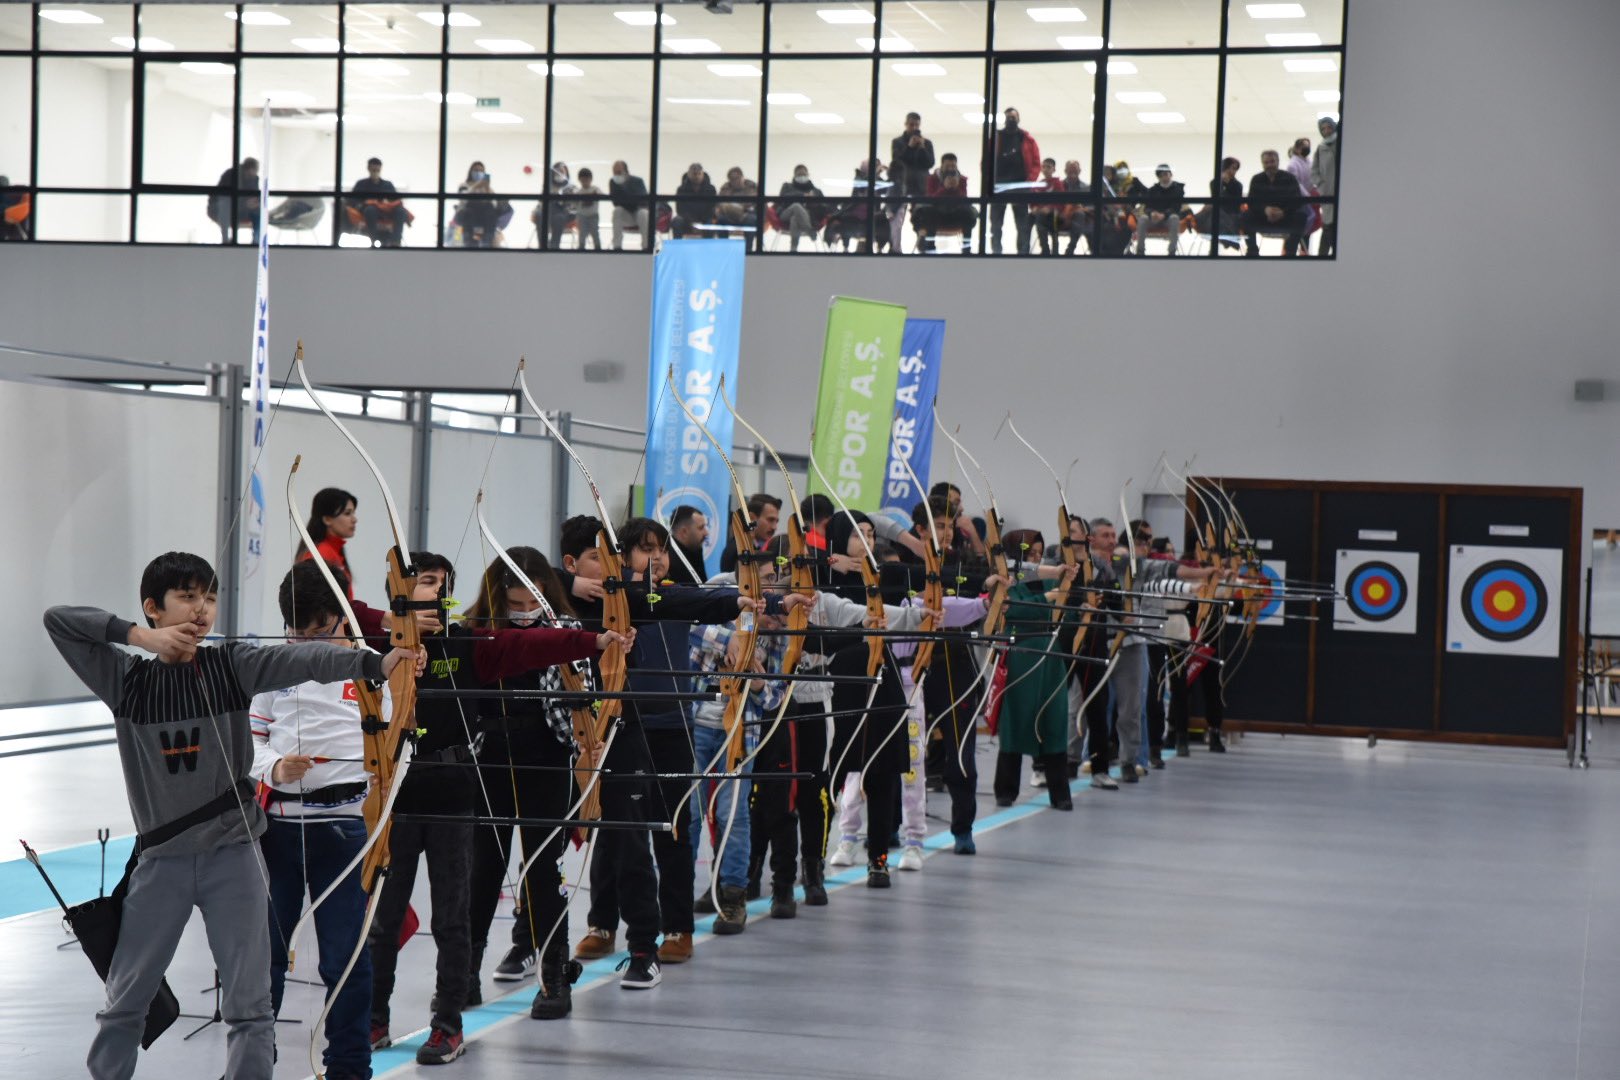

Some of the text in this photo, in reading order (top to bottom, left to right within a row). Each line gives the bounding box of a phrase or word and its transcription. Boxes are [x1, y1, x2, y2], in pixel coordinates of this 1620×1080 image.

[681, 280, 723, 475] SPOR A.Ş.
[850, 336, 885, 399] A.Ş.
[888, 349, 926, 499] SPOR A.Ş.
[837, 410, 870, 499] SPOR
